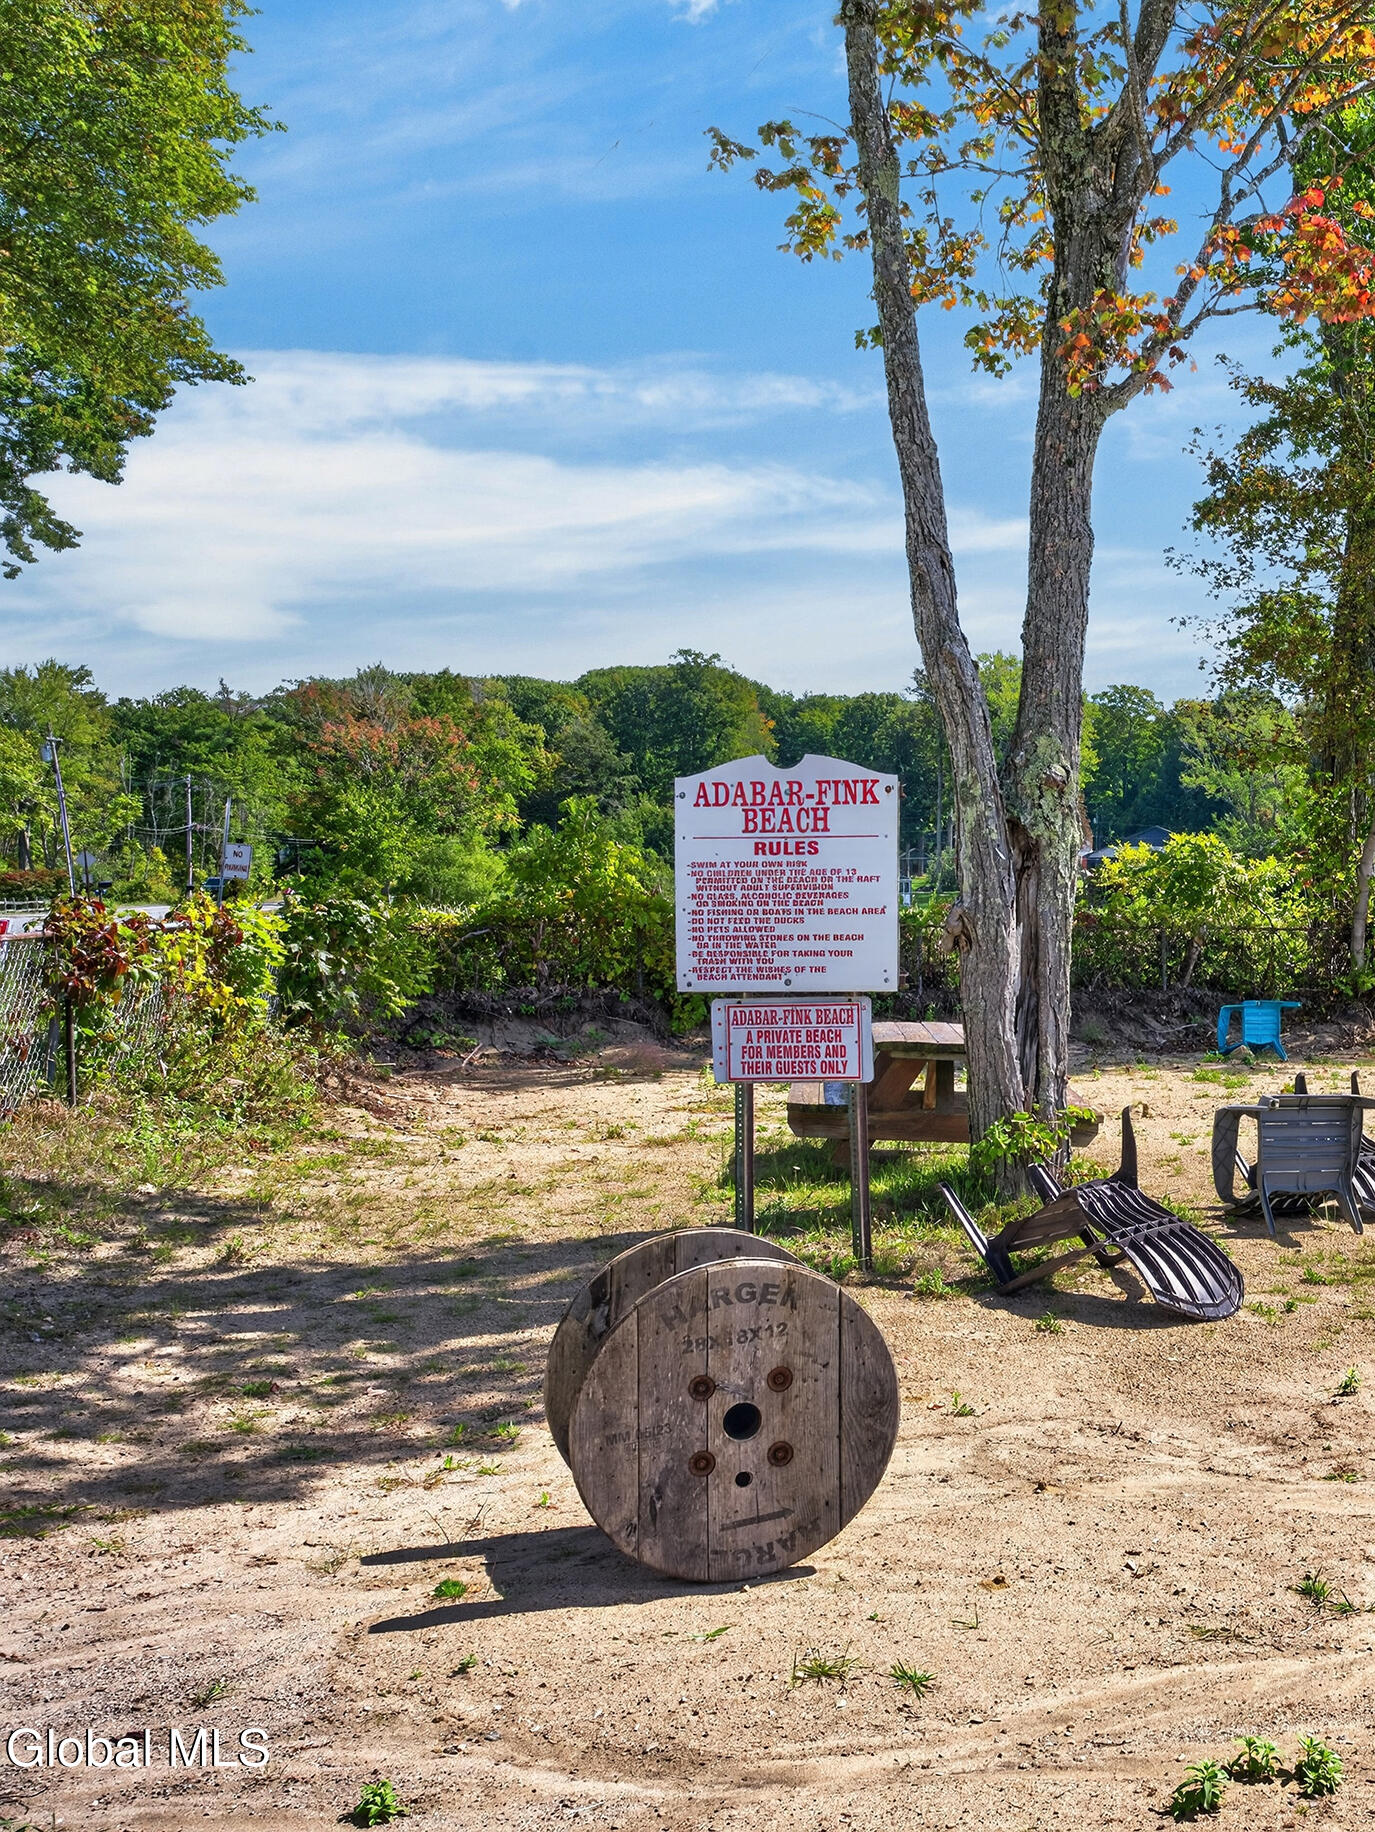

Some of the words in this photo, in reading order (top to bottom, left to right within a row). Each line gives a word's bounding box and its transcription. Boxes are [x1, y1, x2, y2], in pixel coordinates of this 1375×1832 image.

[693, 779, 880, 807] ADABAR-FINK
[742, 807, 830, 833] BEACH
[233, 850, 243, 858] NO
[754, 841, 819, 856] RULES
[731, 1008, 813, 1026] ADABAR-FINK
[816, 1007, 854, 1025] BEACH
[746, 1030, 753, 1044] A
[757, 1029, 802, 1044] PRIVATE
[806, 1029, 842, 1043] BEACH
[742, 1045, 762, 1059] FOR
[767, 1045, 821, 1059] MEMBERS
[825, 1045, 847, 1059] AND
[741, 1061, 772, 1075] THEIR
[776, 1060, 817, 1075] GUESTS
[820, 1060, 848, 1074] ONLY
